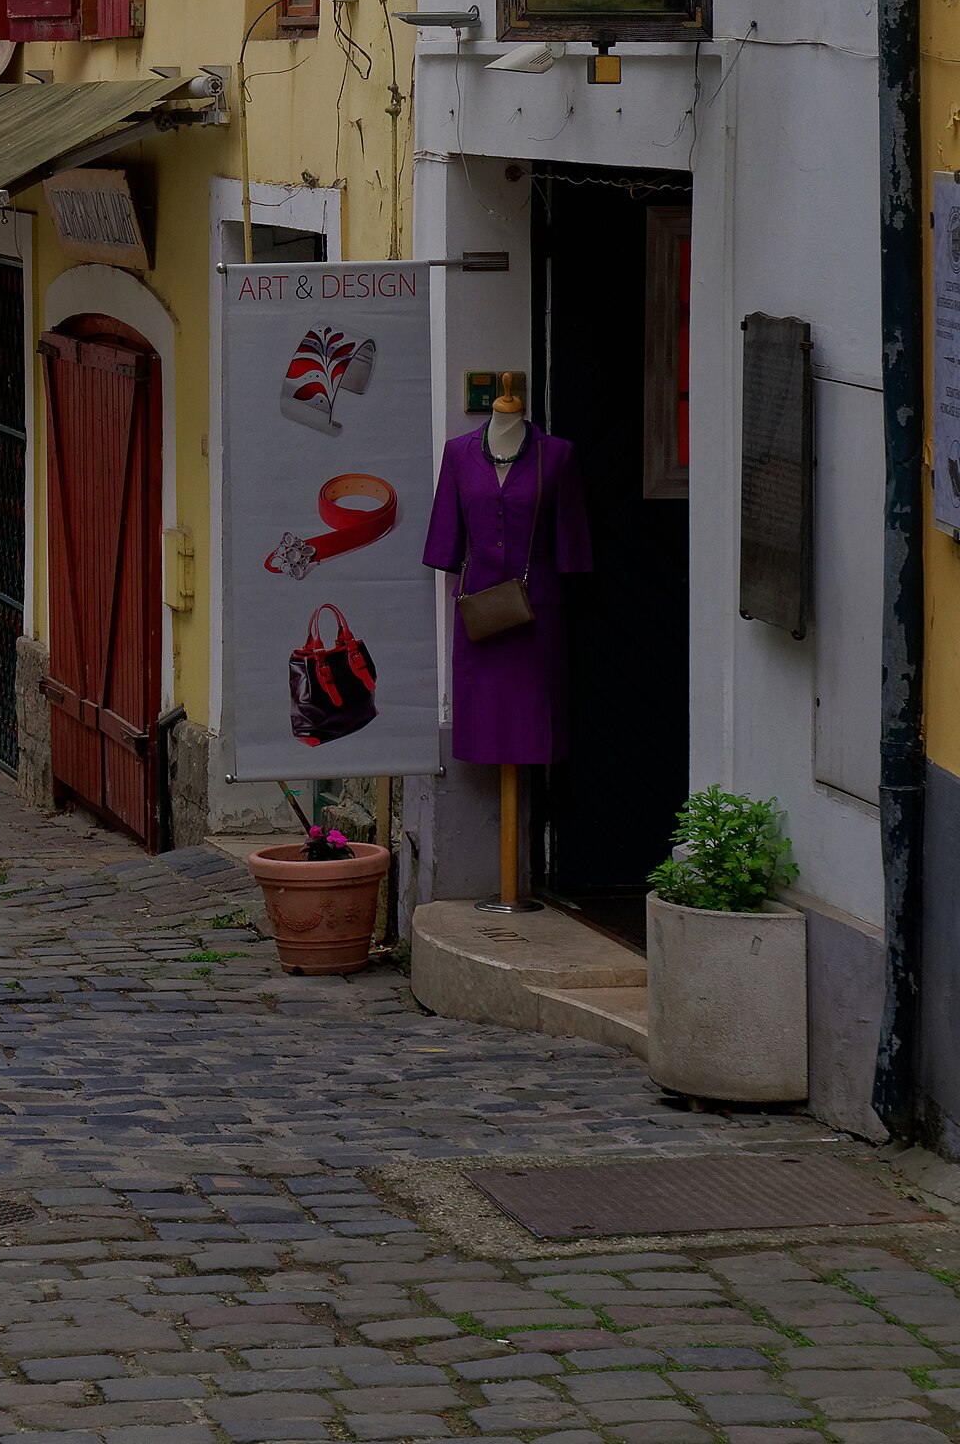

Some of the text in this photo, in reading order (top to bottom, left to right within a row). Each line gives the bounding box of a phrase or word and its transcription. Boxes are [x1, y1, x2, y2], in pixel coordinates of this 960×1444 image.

[239, 273, 416, 301] ART & DESIGN
